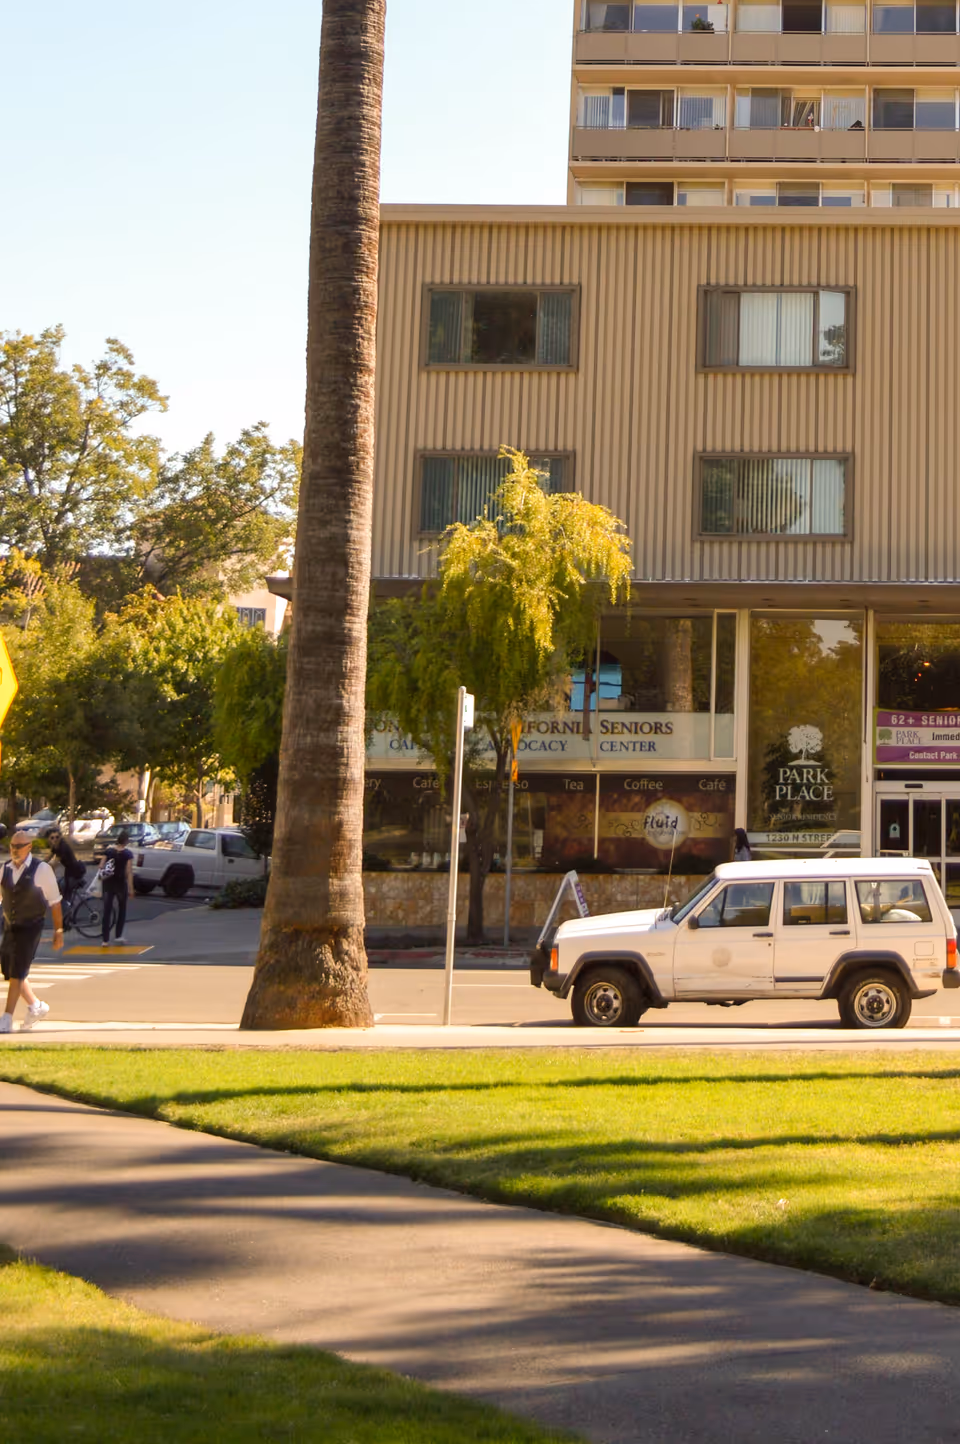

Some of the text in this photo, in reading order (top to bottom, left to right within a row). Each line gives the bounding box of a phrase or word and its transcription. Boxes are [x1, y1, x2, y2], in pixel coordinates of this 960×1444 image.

[891, 715, 915, 725] 62+
[600, 719, 674, 736] SENIORS
[600, 740, 657, 753] CENTER
[909, 751, 938, 760] Contact
[941, 752, 957, 760] Park
[778, 767, 830, 784] PARK
[564, 779, 584, 791] Tea
[624, 778, 664, 791] Coffee
[775, 784, 834, 801] PLACE
[643, 815, 679, 830] fluid
[765, 834, 837, 843] 1230 N STREE
